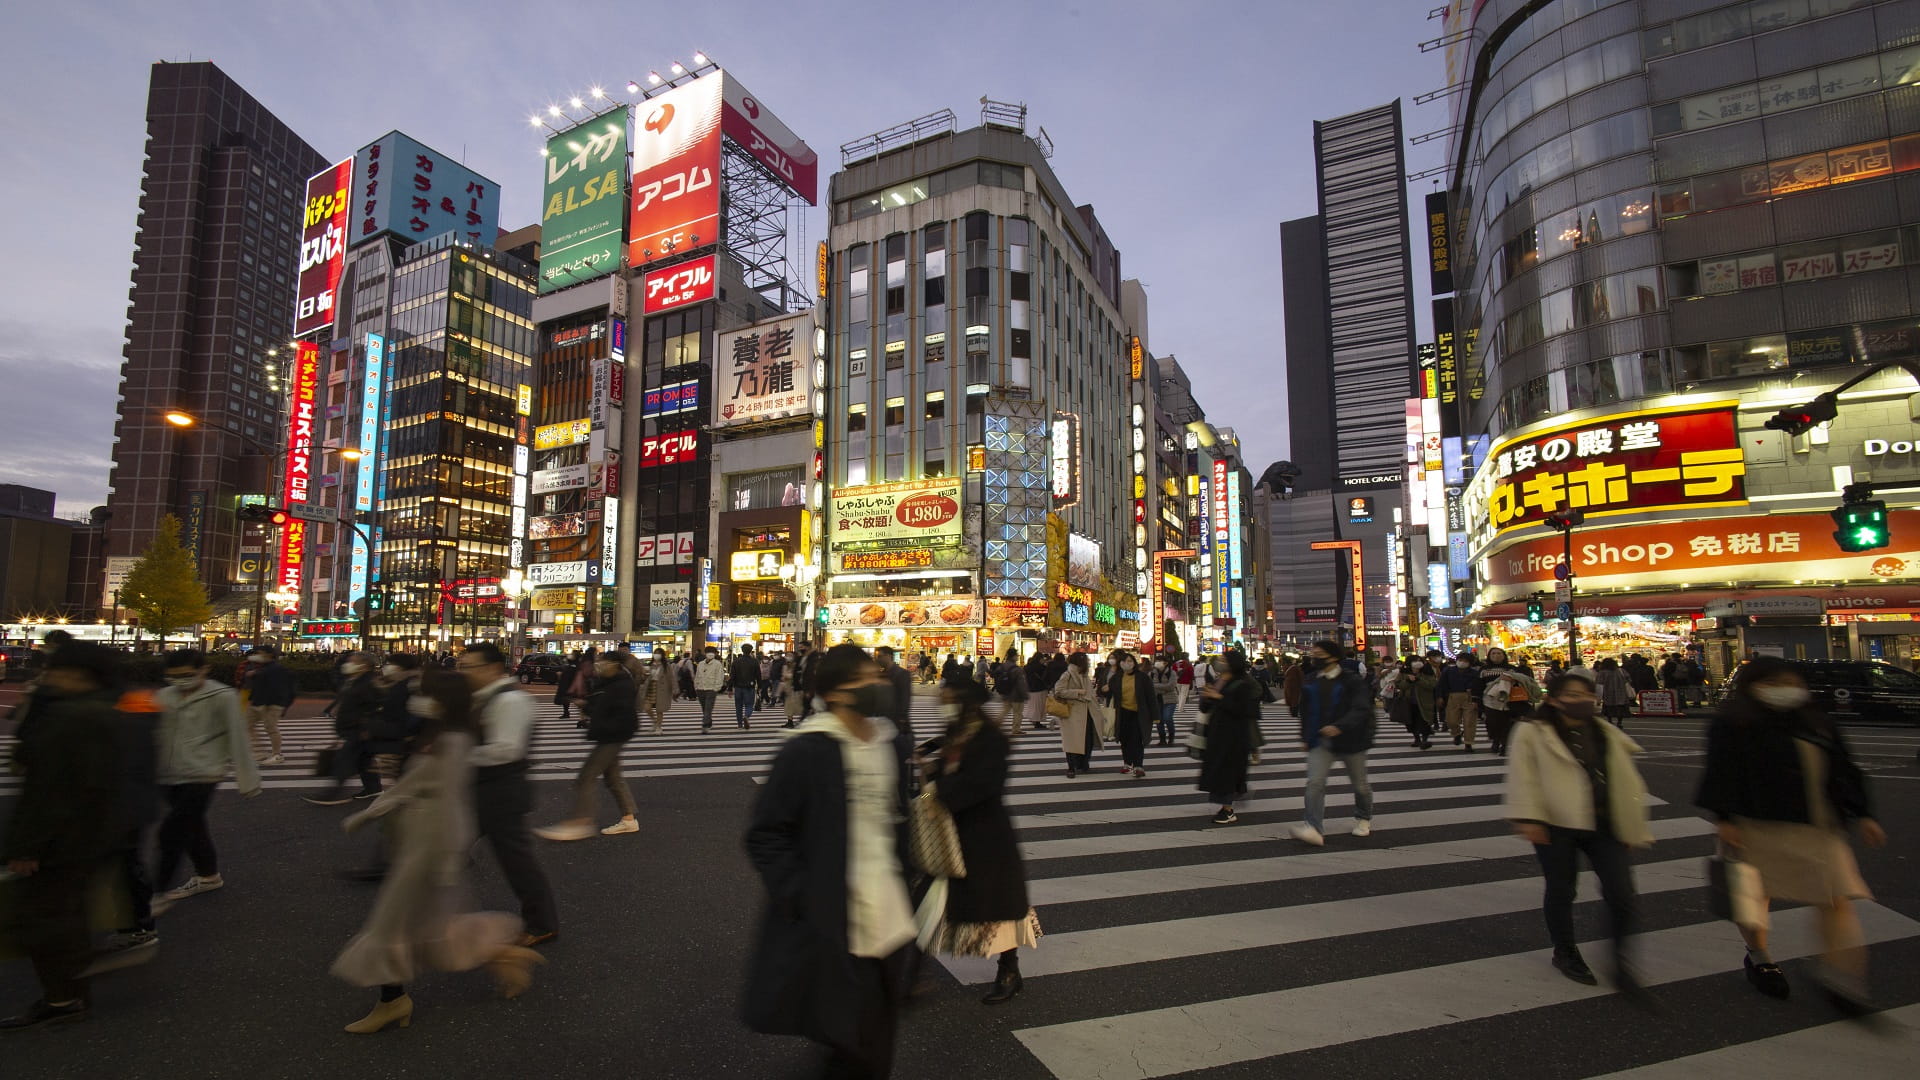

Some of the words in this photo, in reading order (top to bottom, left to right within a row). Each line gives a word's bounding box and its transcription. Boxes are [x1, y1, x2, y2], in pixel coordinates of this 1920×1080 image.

[548, 128, 619, 184] レイク
[751, 129, 795, 181] アコム
[410, 154, 434, 233] カラオケ
[544, 169, 618, 221] ALSA
[637, 166, 712, 211] アコム
[303, 187, 347, 229] パチンコ
[440, 196, 456, 216] &
[300, 226, 343, 272] エスパス
[1740, 266, 1777, 287] 新宿
[1785, 256, 1834, 280] アイドル
[1845, 246, 1897, 272] ステージ
[648, 265, 712, 298] アイフル
[299, 288, 333, 319] 日拓
[732, 327, 795, 368] 養老
[731, 360, 795, 400] 乃瀧
[647, 385, 698, 406] PROMISE
[737, 395, 807, 415] 24時間営業中
[643, 435, 697, 457] アイフル
[834, 485, 889, 498] All-you-can-eat
[890, 482, 913, 493] buffet
[914, 481, 927, 489] for
[928, 480, 934, 488] 2
[935, 478, 960, 488] hours
[1344, 477, 1371, 486] HOTEL
[836, 495, 896, 511] しゃぶしゃぶ
[903, 505, 942, 524] 1,980
[838, 515, 893, 531] 食べ放題!
[287, 522, 304, 564] パチンコ
[639, 538, 695, 558] アコム
[945, 535, 961, 545] 5F
[1508, 559, 1524, 577] Tax
[1527, 552, 1573, 571] Free
[1582, 542, 1674, 566] Shop
[1689, 531, 1800, 557] 免税店
[542, 573, 576, 584] クリニック
[590, 566, 598, 577] 3
[1826, 597, 1886, 609] uijote
